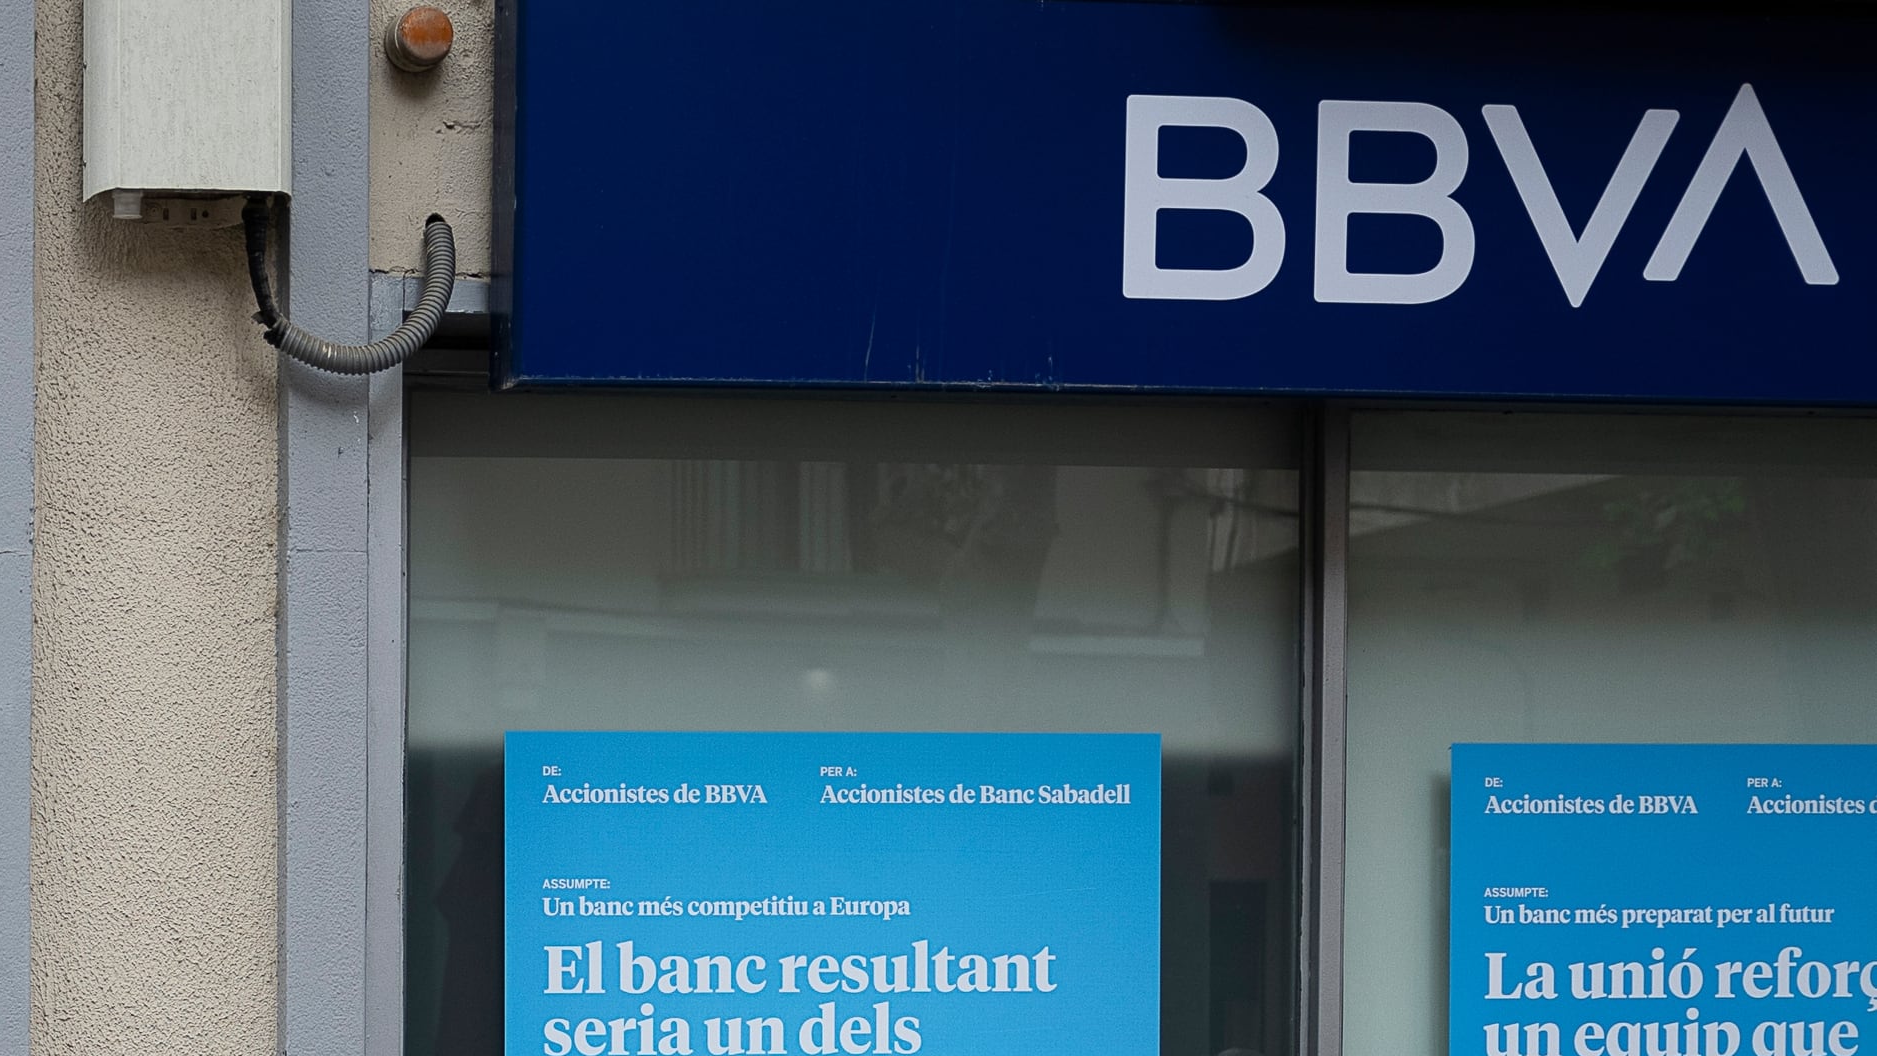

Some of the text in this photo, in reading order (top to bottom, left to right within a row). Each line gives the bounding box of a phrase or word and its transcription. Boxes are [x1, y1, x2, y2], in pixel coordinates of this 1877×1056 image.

[1122, 82, 1840, 309] BBVA
[542, 765, 562, 777] DE:
[819, 766, 858, 777] PER A:
[1484, 776, 1504, 788] DE:
[541, 782, 768, 804] Accionistes de BBVA
[1746, 777, 1782, 788] PER A:
[819, 783, 1132, 805] Accionistes de Banc Sabadell
[1484, 793, 1699, 815] Accionistes de BBVA
[1746, 793, 1866, 815] Accionistes
[542, 878, 611, 890] ASSUMPTE:
[1483, 887, 1549, 898] ASSUMPTE:
[541, 895, 911, 921] Un banc més competitiu a Europa
[1483, 902, 1835, 929] Un banc més preparat per al futur
[543, 939, 1058, 995] El banc resultant
[1484, 952, 1559, 1000] La
[1567, 946, 1704, 1001] unió
[543, 1000, 922, 1056] seria un dels
